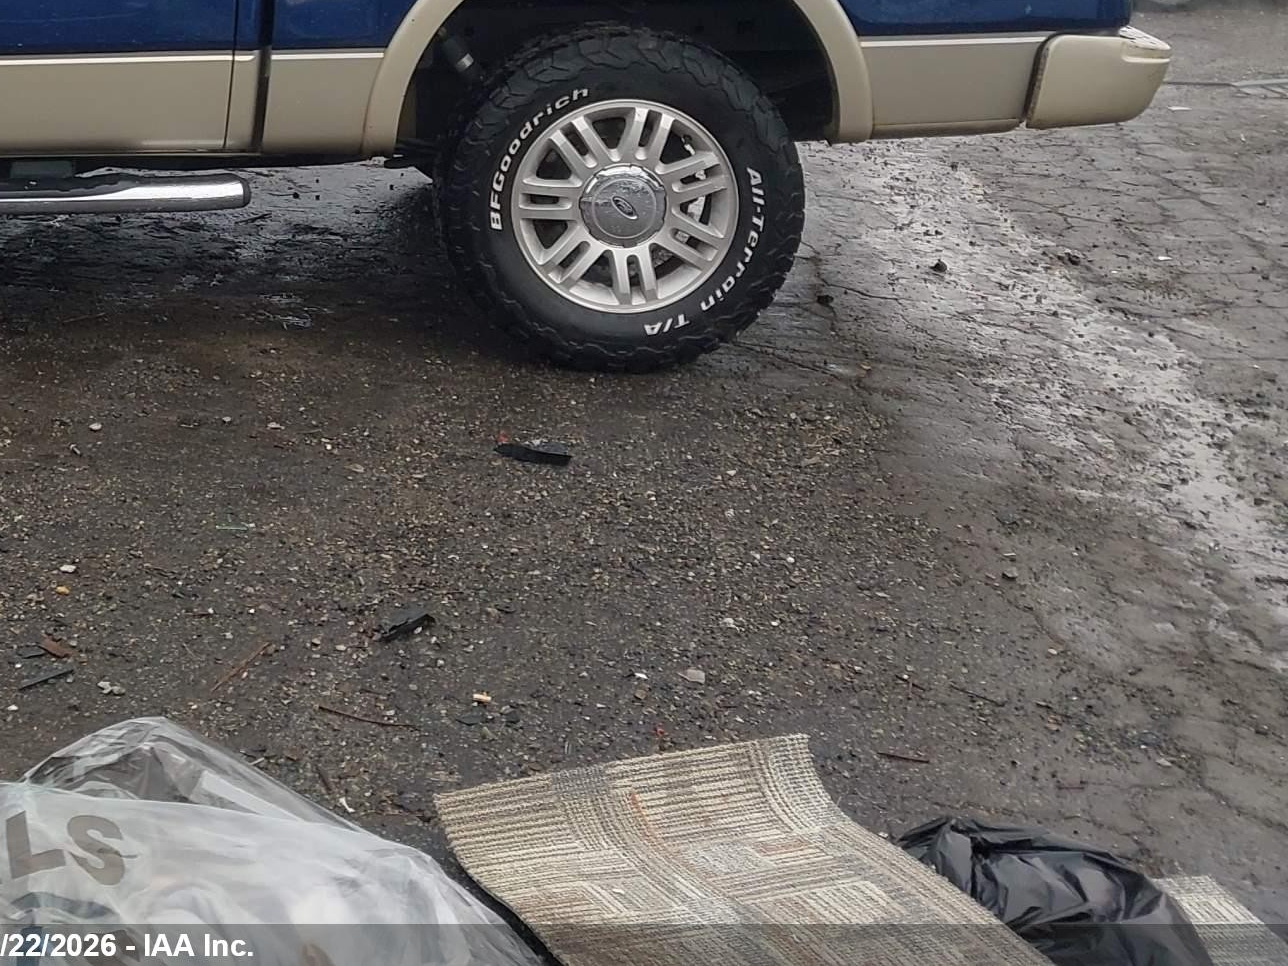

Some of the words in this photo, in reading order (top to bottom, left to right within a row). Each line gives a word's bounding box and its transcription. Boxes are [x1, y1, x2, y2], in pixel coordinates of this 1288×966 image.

[490, 87, 589, 231] BFGoodrich
[700, 167, 765, 312] All-Terrain
[643, 313, 690, 336] T/A
